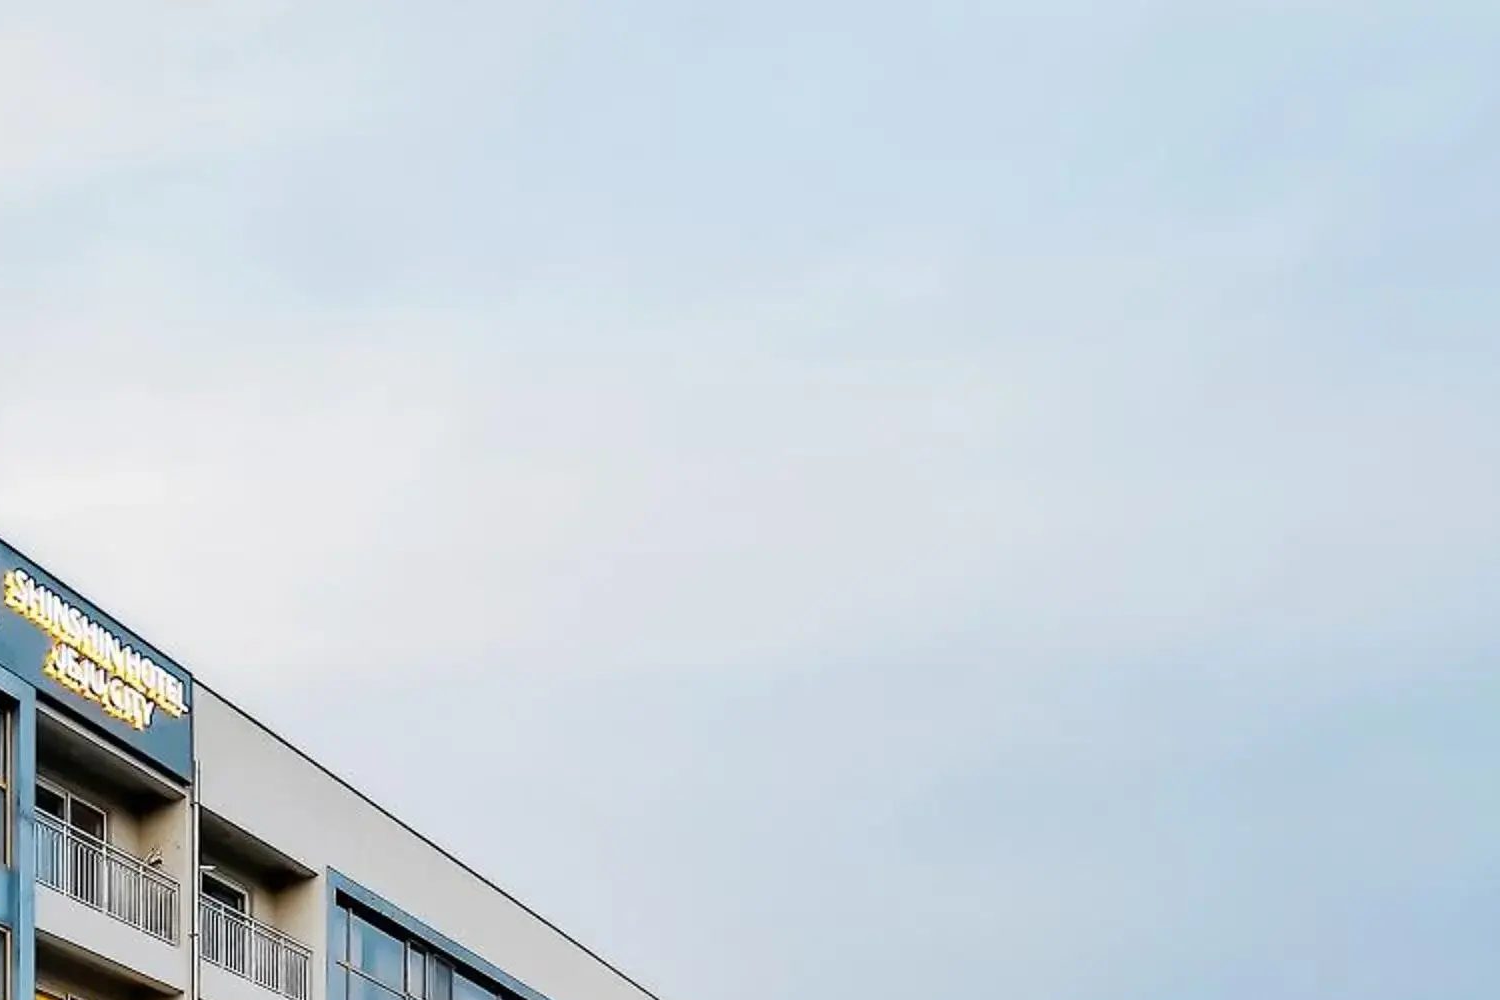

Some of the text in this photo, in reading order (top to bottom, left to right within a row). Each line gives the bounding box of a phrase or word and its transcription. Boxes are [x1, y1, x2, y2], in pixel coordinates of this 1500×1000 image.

[44, 641, 155, 730] JEJU CITY
[119, 645, 190, 718] HOTEL
